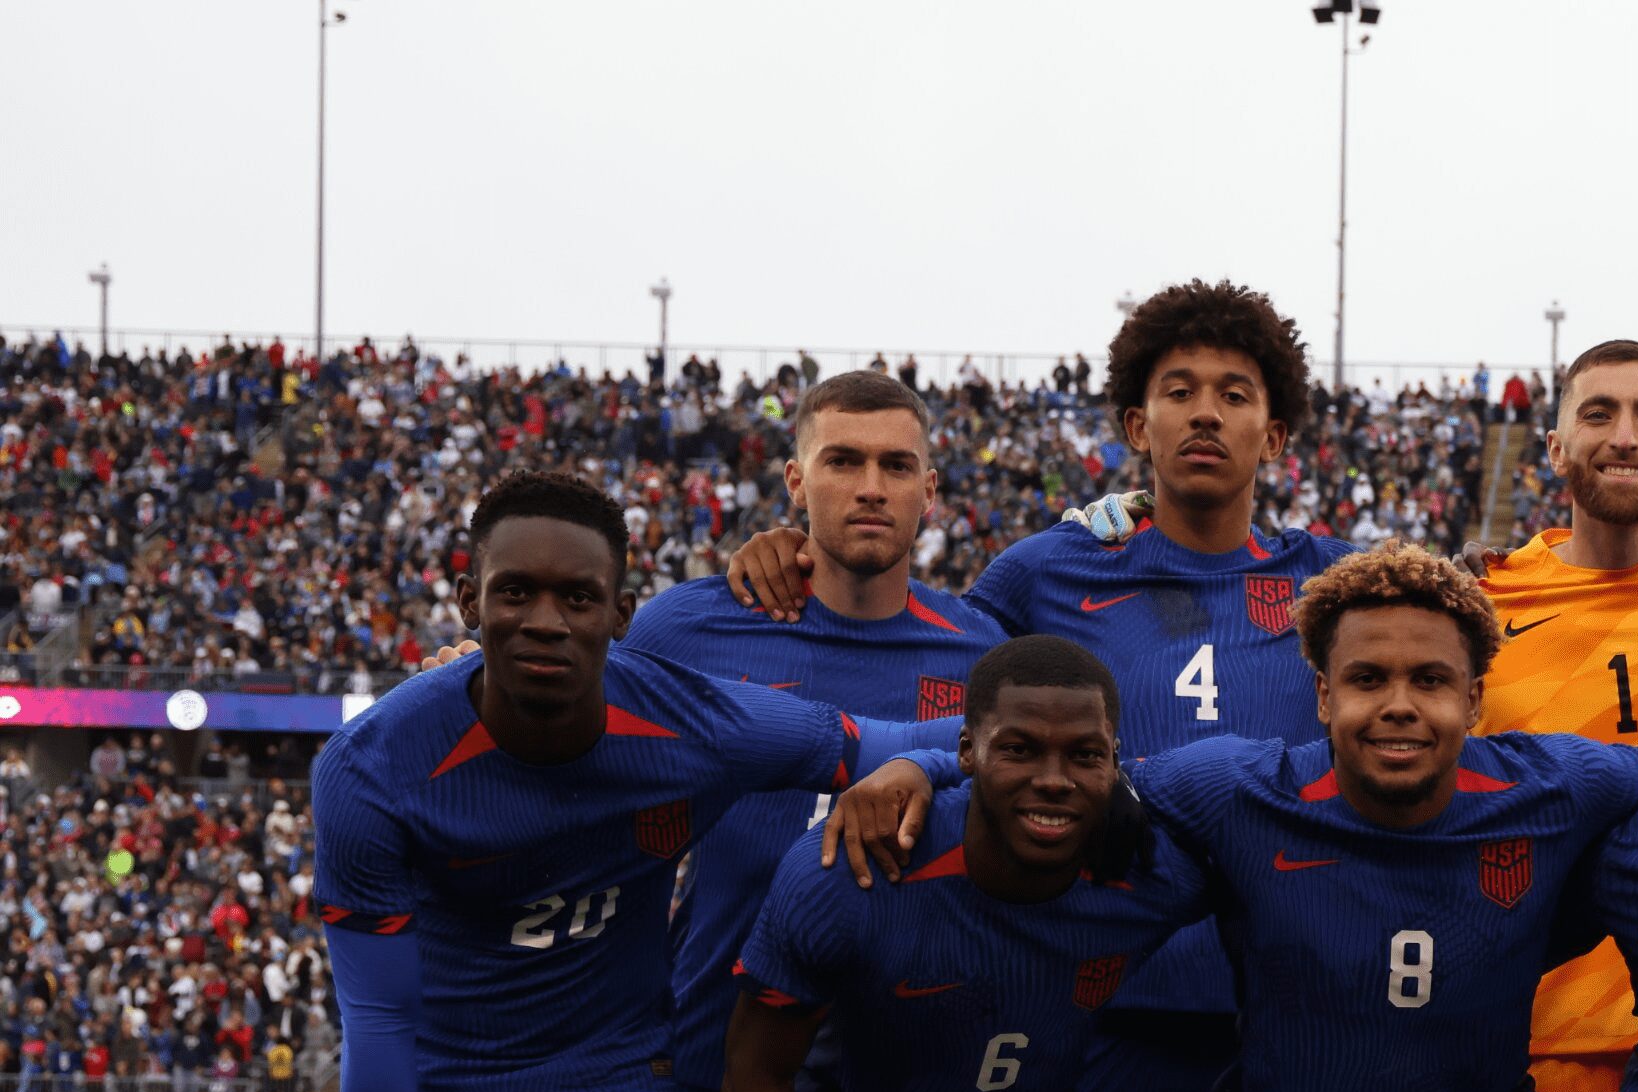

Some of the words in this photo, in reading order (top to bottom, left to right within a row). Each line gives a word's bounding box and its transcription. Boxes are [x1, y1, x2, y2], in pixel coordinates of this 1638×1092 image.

[1247, 580, 1291, 605] USA
[922, 679, 963, 708] USA
[1175, 644, 1219, 721] 4
[1607, 653, 1638, 734] 1
[1480, 840, 1528, 868] USA
[510, 885, 622, 949] 20
[1077, 956, 1122, 980] USA
[1388, 929, 1435, 1008] 8
[975, 1032, 1030, 1092] 6
